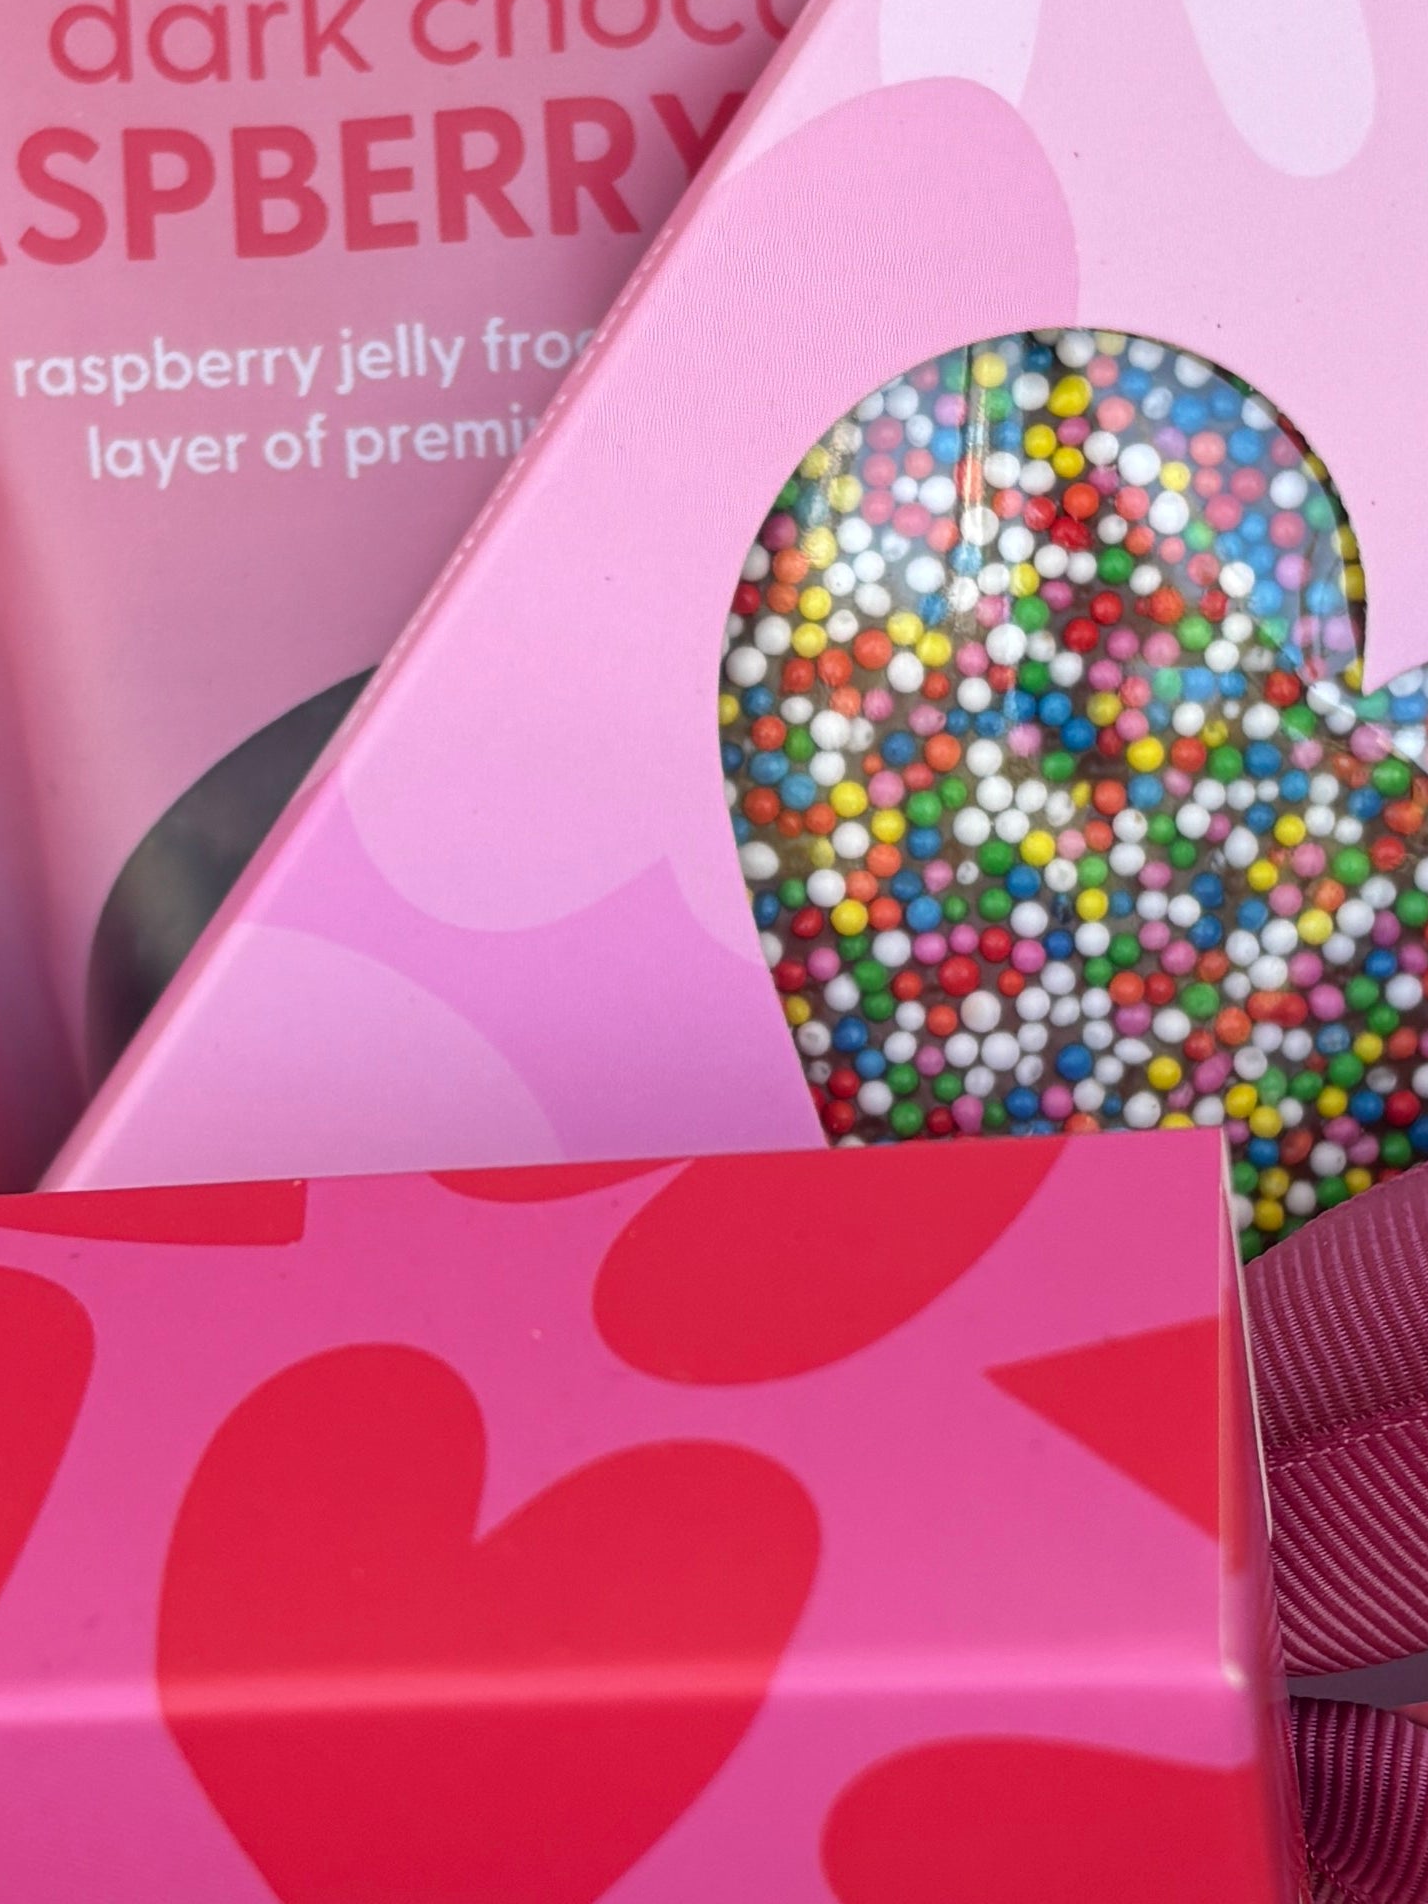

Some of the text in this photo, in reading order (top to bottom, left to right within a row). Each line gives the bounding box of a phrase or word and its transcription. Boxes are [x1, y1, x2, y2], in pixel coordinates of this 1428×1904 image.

[13, 336, 323, 405] raspberry
[335, 323, 465, 395] jelly
[87, 401, 542, 491] layer of premi
